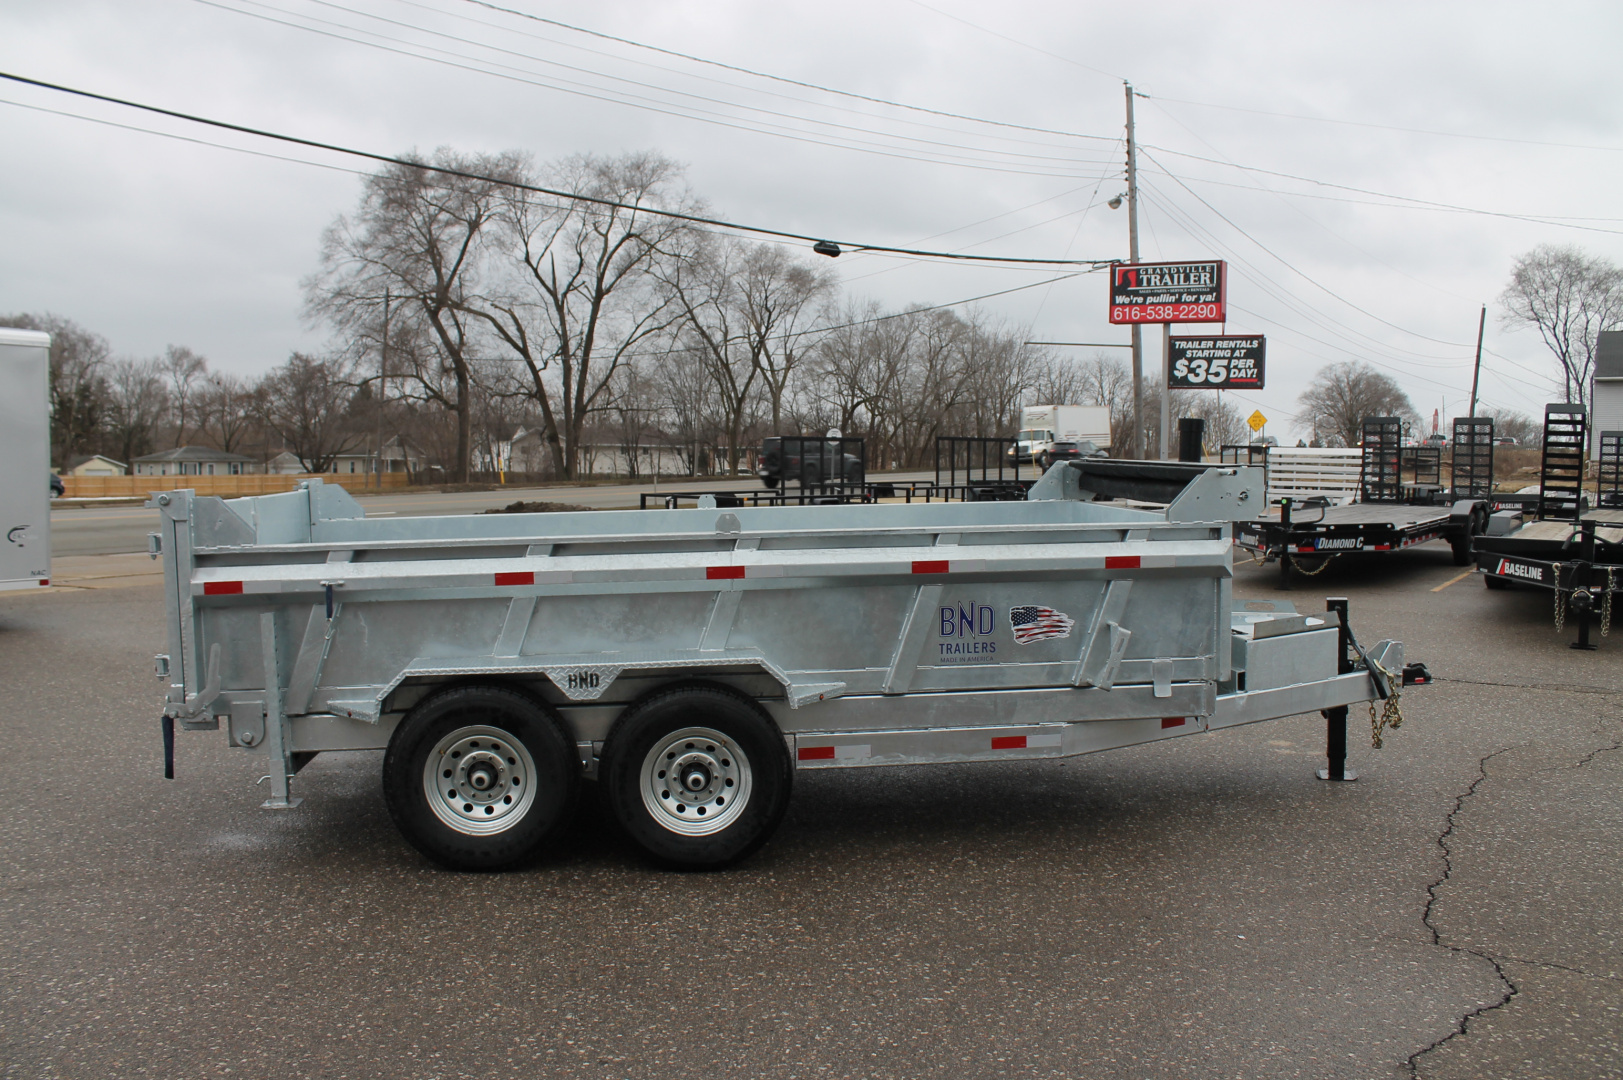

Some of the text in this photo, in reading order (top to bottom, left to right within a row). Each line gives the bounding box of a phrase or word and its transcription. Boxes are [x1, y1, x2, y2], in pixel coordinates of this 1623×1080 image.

[1140, 265, 1212, 275] GRANDVILLE
[1139, 273, 1211, 286] TRAILER
[1115, 292, 1217, 305] We're pullin' for ya!
[1114, 305, 1216, 320] 616-538-2290
[1216, 340, 1258, 348] RENTALS
[1185, 349, 1246, 358] STARTING AT
[1174, 358, 1228, 383] $35
[1230, 359, 1255, 369] PER
[1230, 368, 1258, 378] DAY!
[1319, 536, 1364, 549] DIAMOND C
[1504, 561, 1543, 581] BASELINE
[939, 601, 995, 639] BND
[939, 642, 996, 654] TRAILERS
[568, 671, 600, 688] BND
